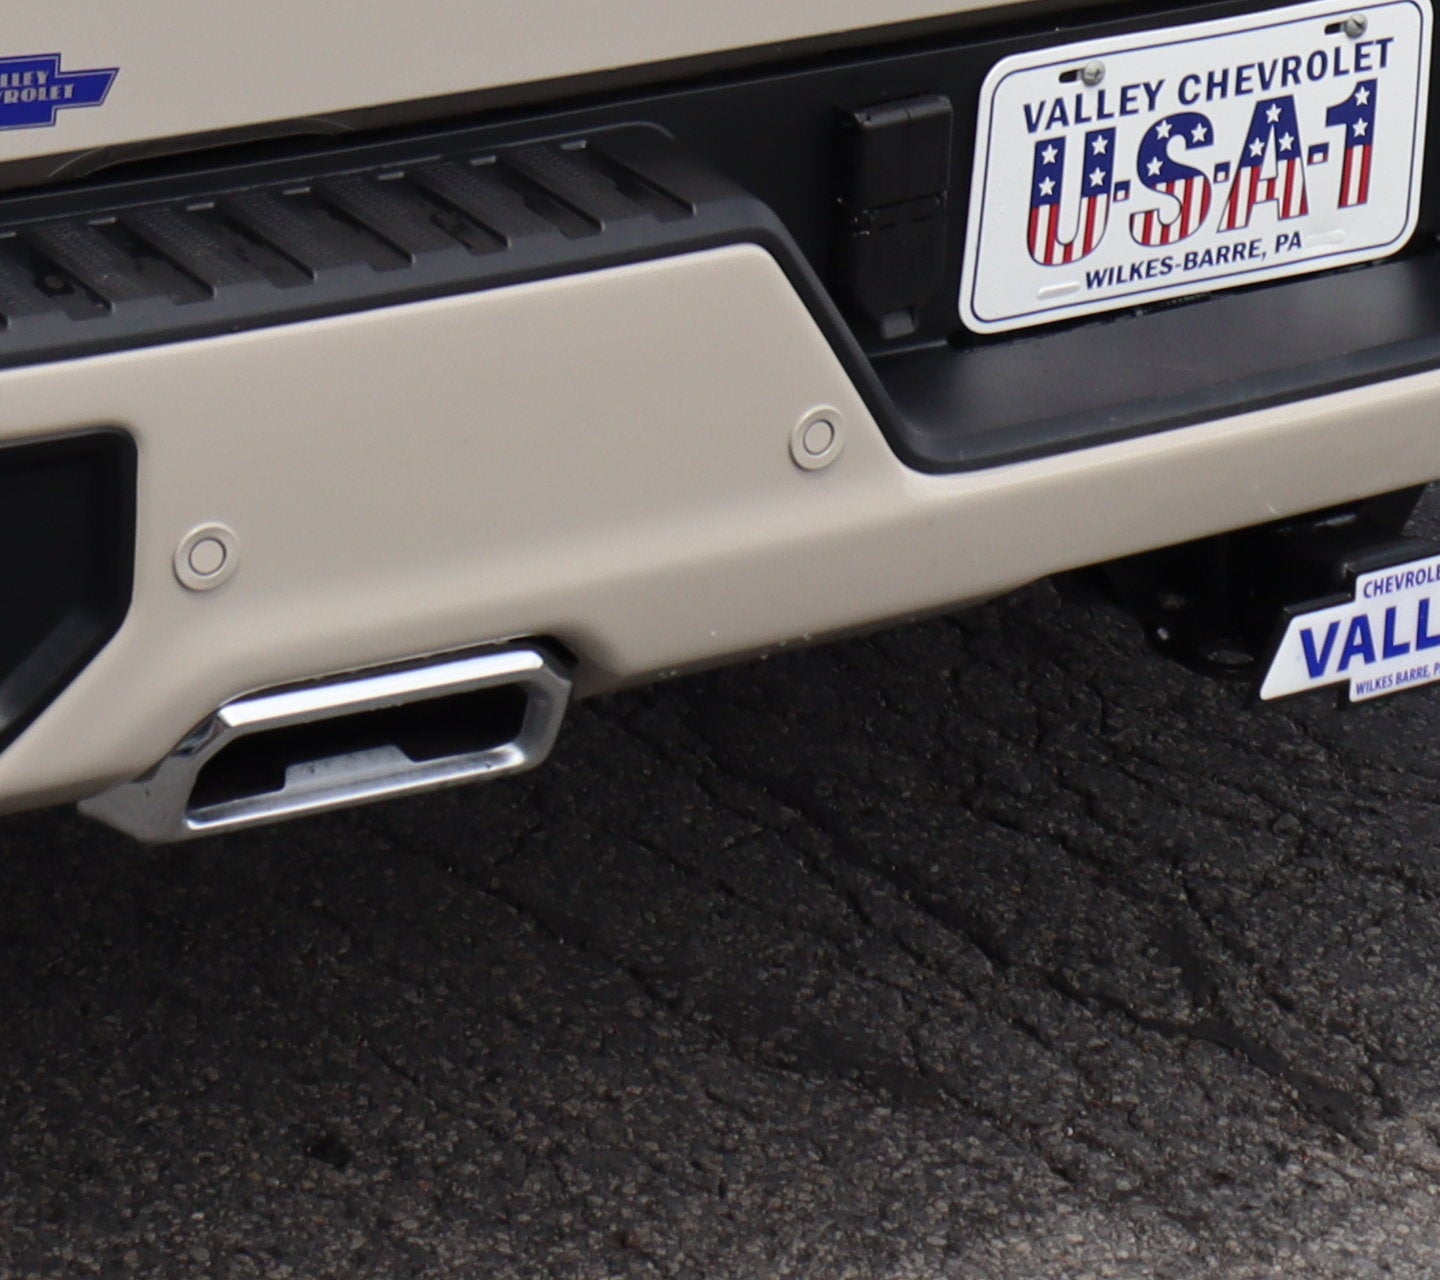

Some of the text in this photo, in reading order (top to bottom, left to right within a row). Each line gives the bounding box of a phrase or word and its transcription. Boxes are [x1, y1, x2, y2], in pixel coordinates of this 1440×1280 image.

[1023, 37, 1394, 133] VALLEY CHEVROLET
[1085, 231, 1303, 290] WILKES-BARRE, PA
[1355, 673, 1393, 695] WILKES
[1395, 664, 1431, 685] BARRE,
